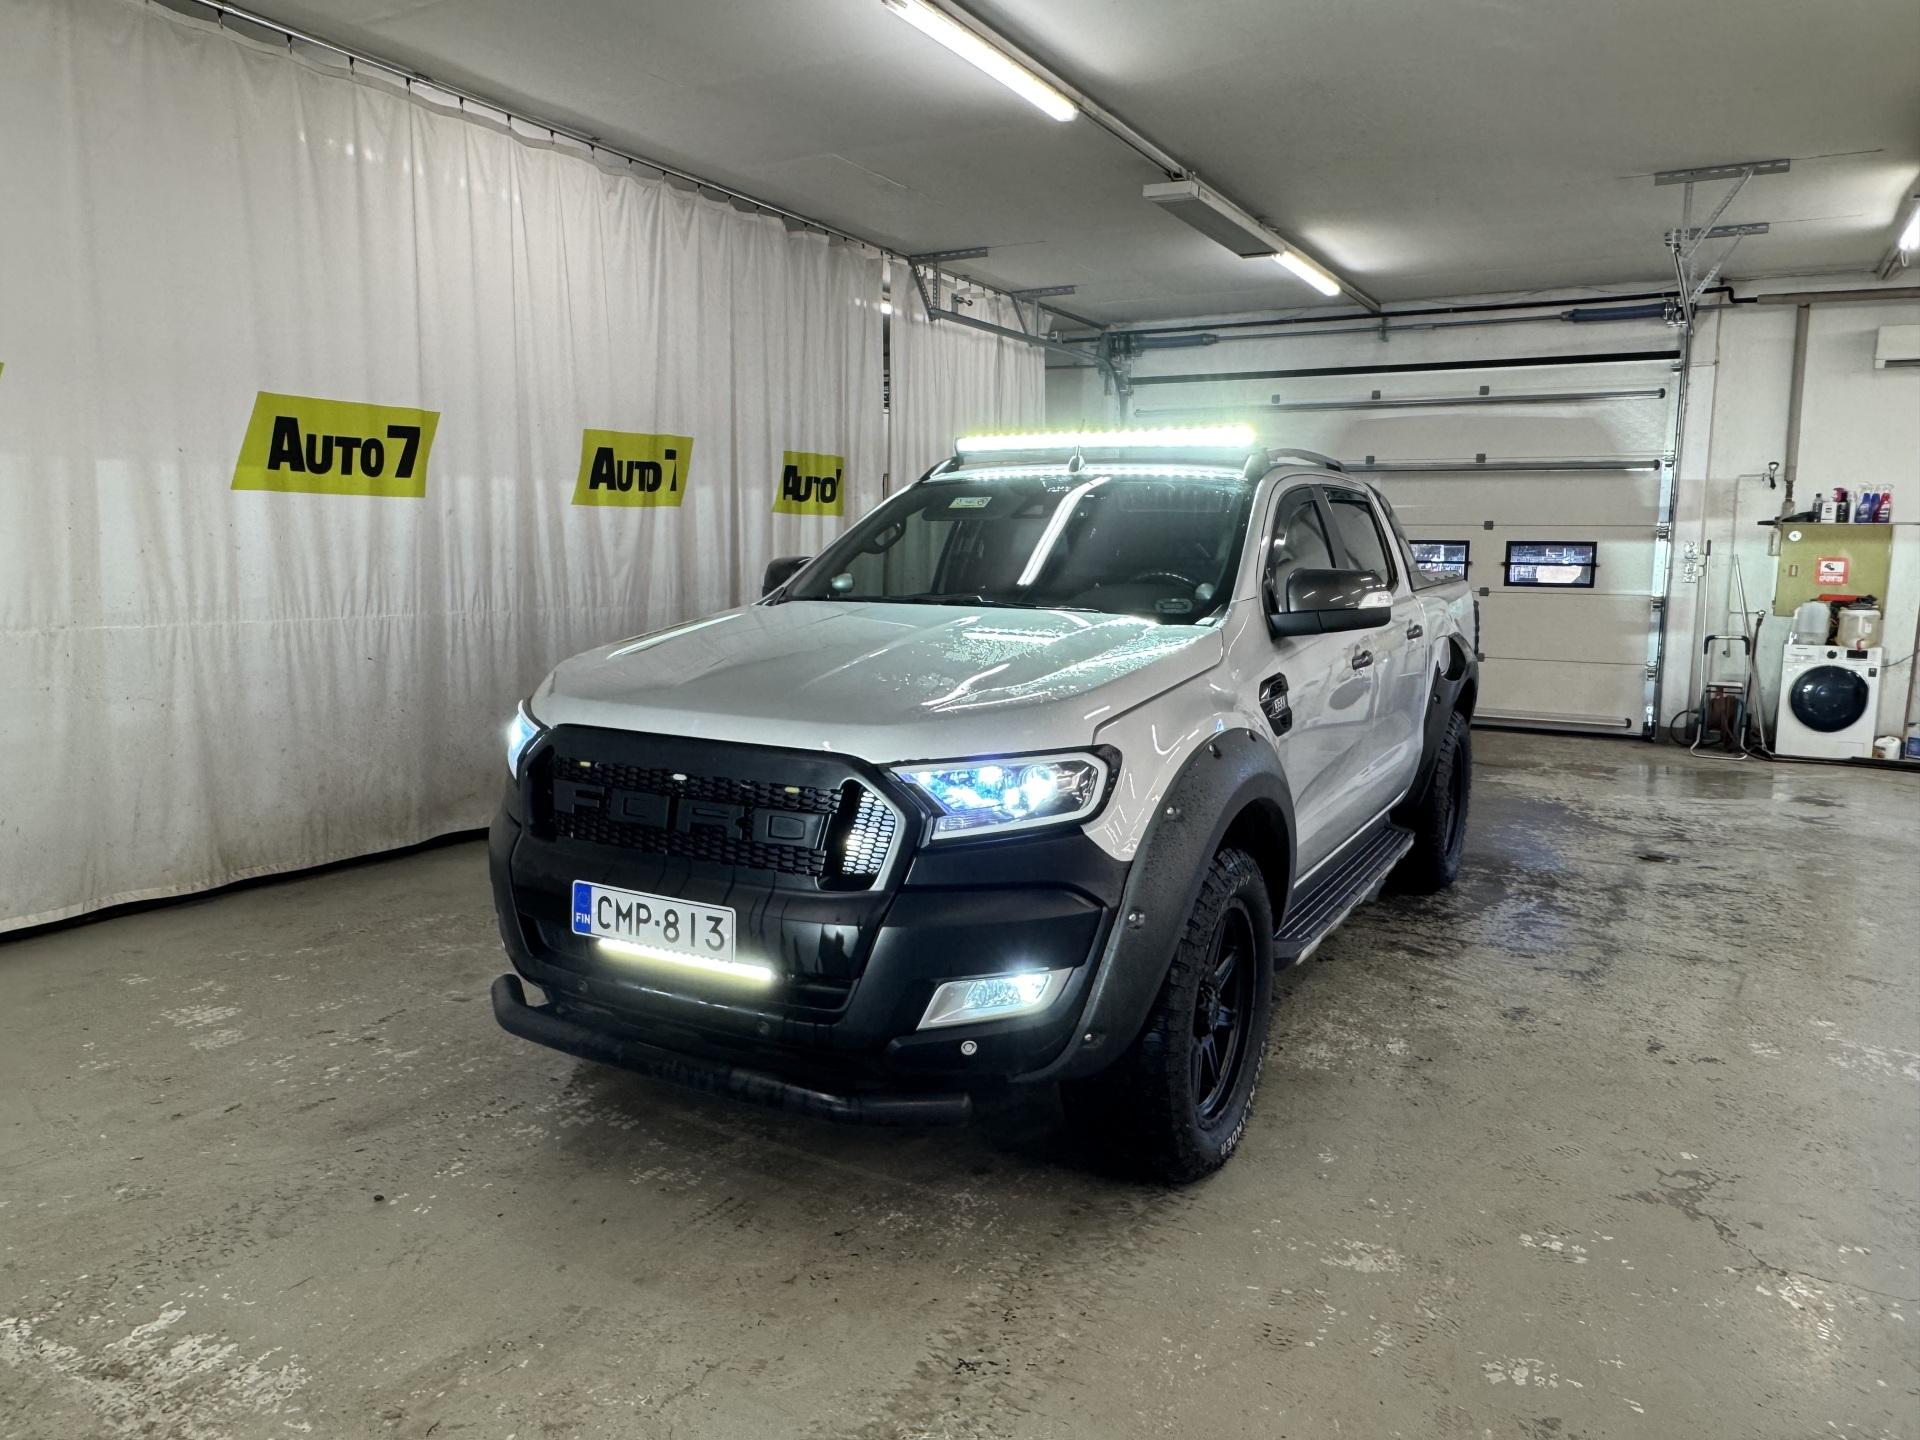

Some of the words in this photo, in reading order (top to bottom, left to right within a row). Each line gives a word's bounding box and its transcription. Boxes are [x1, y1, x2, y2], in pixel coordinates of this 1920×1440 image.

[553, 778, 824, 850] FORD
[575, 911, 591, 924] FIN
[597, 895, 726, 951] CMP-813
